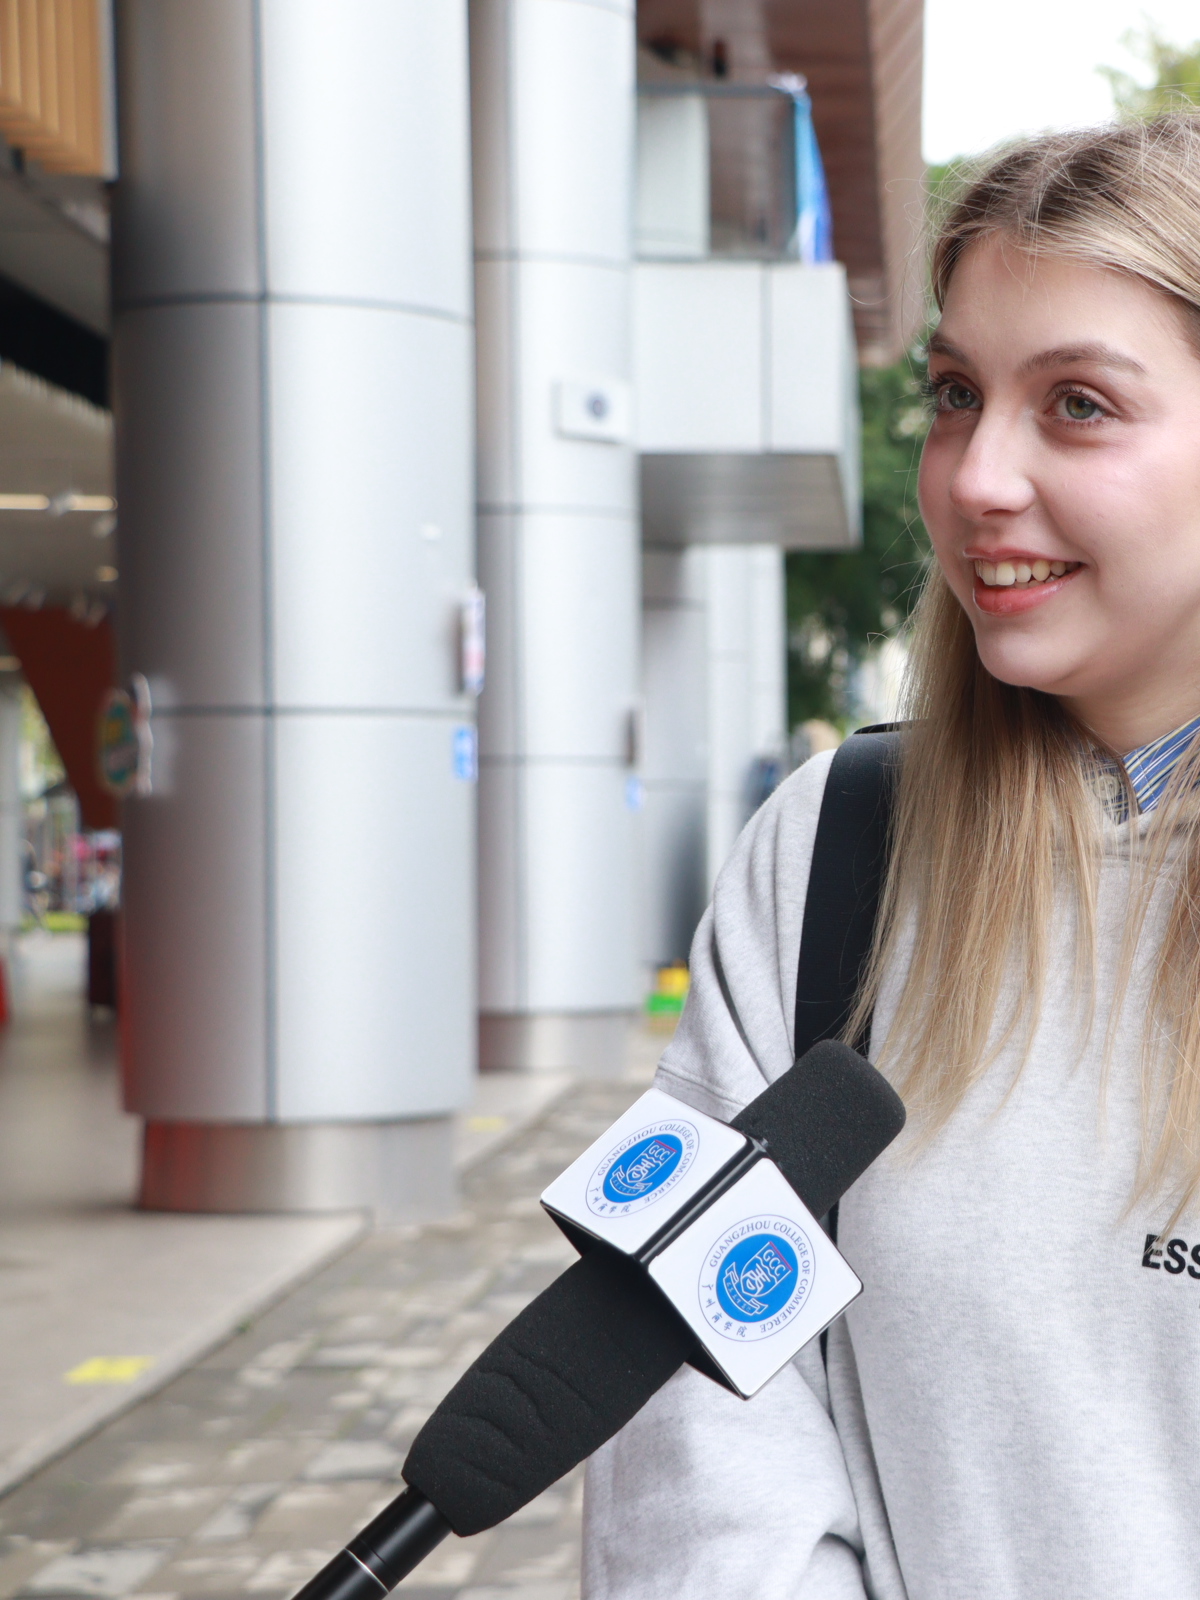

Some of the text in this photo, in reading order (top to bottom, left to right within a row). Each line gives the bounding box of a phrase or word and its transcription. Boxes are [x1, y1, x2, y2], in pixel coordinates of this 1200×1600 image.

[659, 1123, 692, 1140] COLLEGE
[686, 1139, 694, 1150] OF
[598, 1127, 656, 1176] GUANGZHOU
[648, 1144, 670, 1161] GCC
[644, 1152, 692, 1203] COMMERCE
[709, 1220, 771, 1268] GUANGZHOU
[773, 1221, 808, 1258] COLLEGE
[762, 1249, 786, 1277] GCC
[801, 1260, 810, 1275] OF
[759, 1278, 809, 1333] COMMERCE
